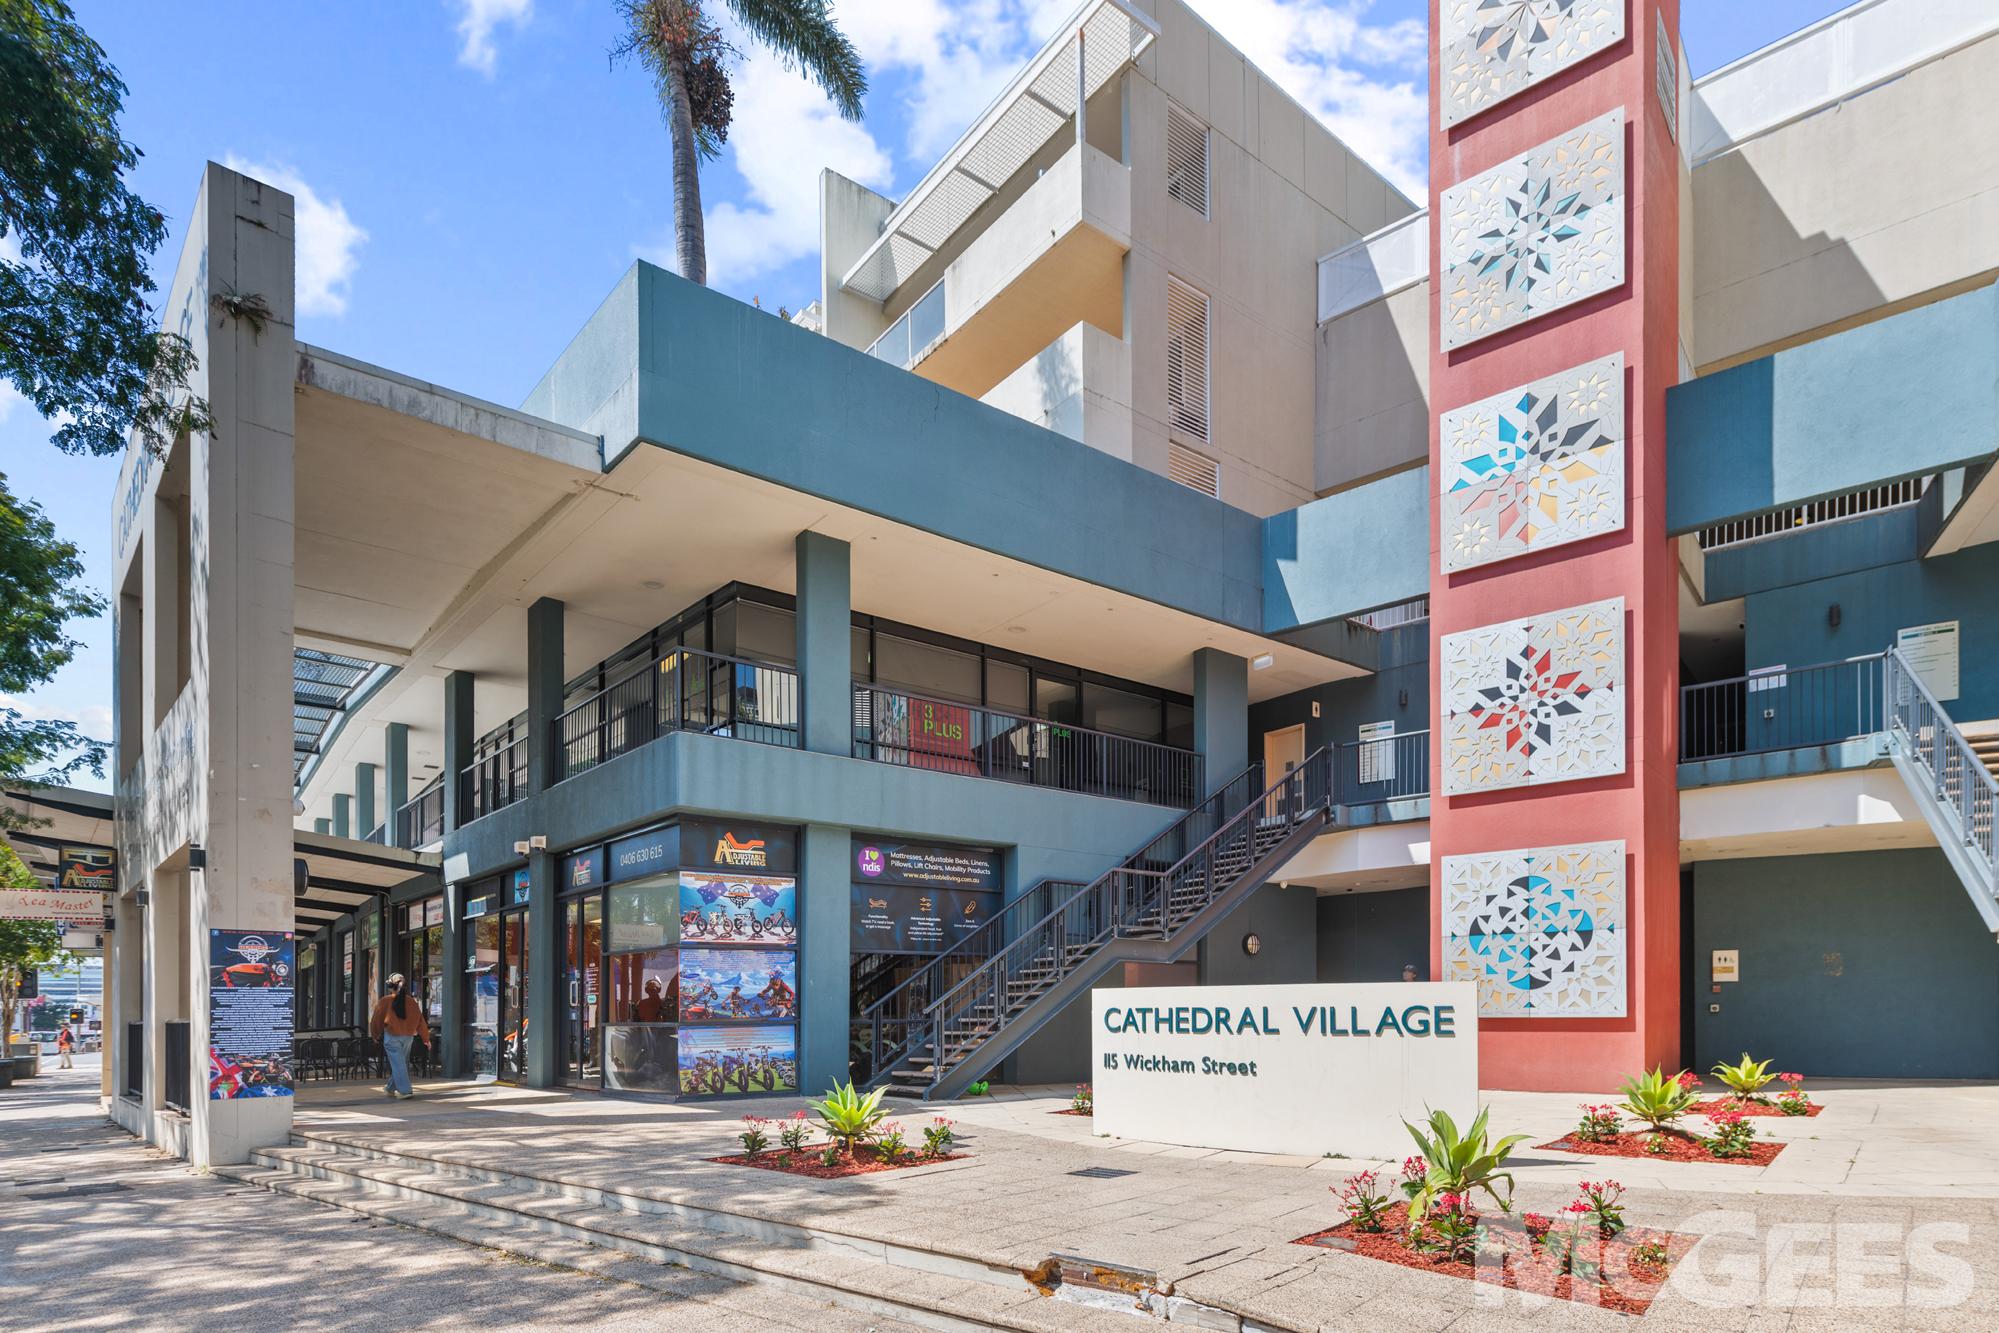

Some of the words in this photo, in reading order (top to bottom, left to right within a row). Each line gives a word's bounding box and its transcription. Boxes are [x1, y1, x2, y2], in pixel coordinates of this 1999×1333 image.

[924, 703, 933, 719] 3
[923, 719, 962, 740] PLUS
[620, 851, 635, 867] 0406
[636, 848, 648, 864] 630
[649, 844, 663, 860] 615
[714, 840, 766, 863] ADJUSTABLE
[864, 850, 870, 861] I
[890, 851, 923, 861] Mattresses,
[924, 854, 954, 864] Adjustable
[735, 859, 767, 867] LIVING
[863, 862, 881, 872] ndis
[890, 861, 913, 869] Pillows,
[924, 863, 944, 871] Chairs,
[944, 865, 966, 873] Mobility
[967, 867, 991, 875] Products
[903, 872, 980, 884] www.adjustableliving.com.au
[49, 898, 95, 910] Master
[1104, 1006, 1280, 1035] CATHEDRAL
[1292, 1005, 1456, 1038] VILLAGE
[1104, 1053, 1119, 1070] 115
[1123, 1053, 1196, 1074] Wickham
[1201, 1056, 1258, 1077] Street
